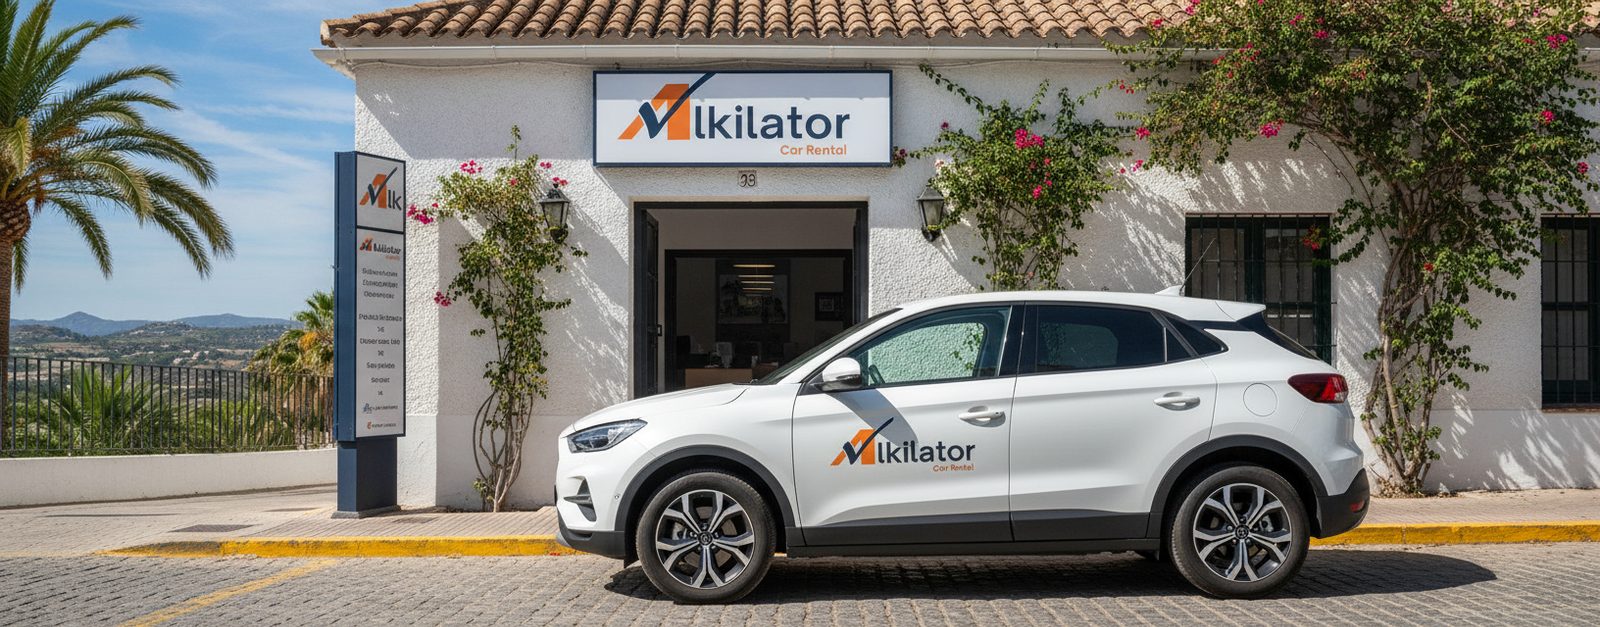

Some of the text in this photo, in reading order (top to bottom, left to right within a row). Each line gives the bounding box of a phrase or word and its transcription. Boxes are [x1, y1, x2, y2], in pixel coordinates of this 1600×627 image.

[618, 72, 850, 140] Alkilator
[780, 144, 847, 156] Car Rental
[830, 417, 976, 466] Alkilator
[932, 464, 949, 472] Car
